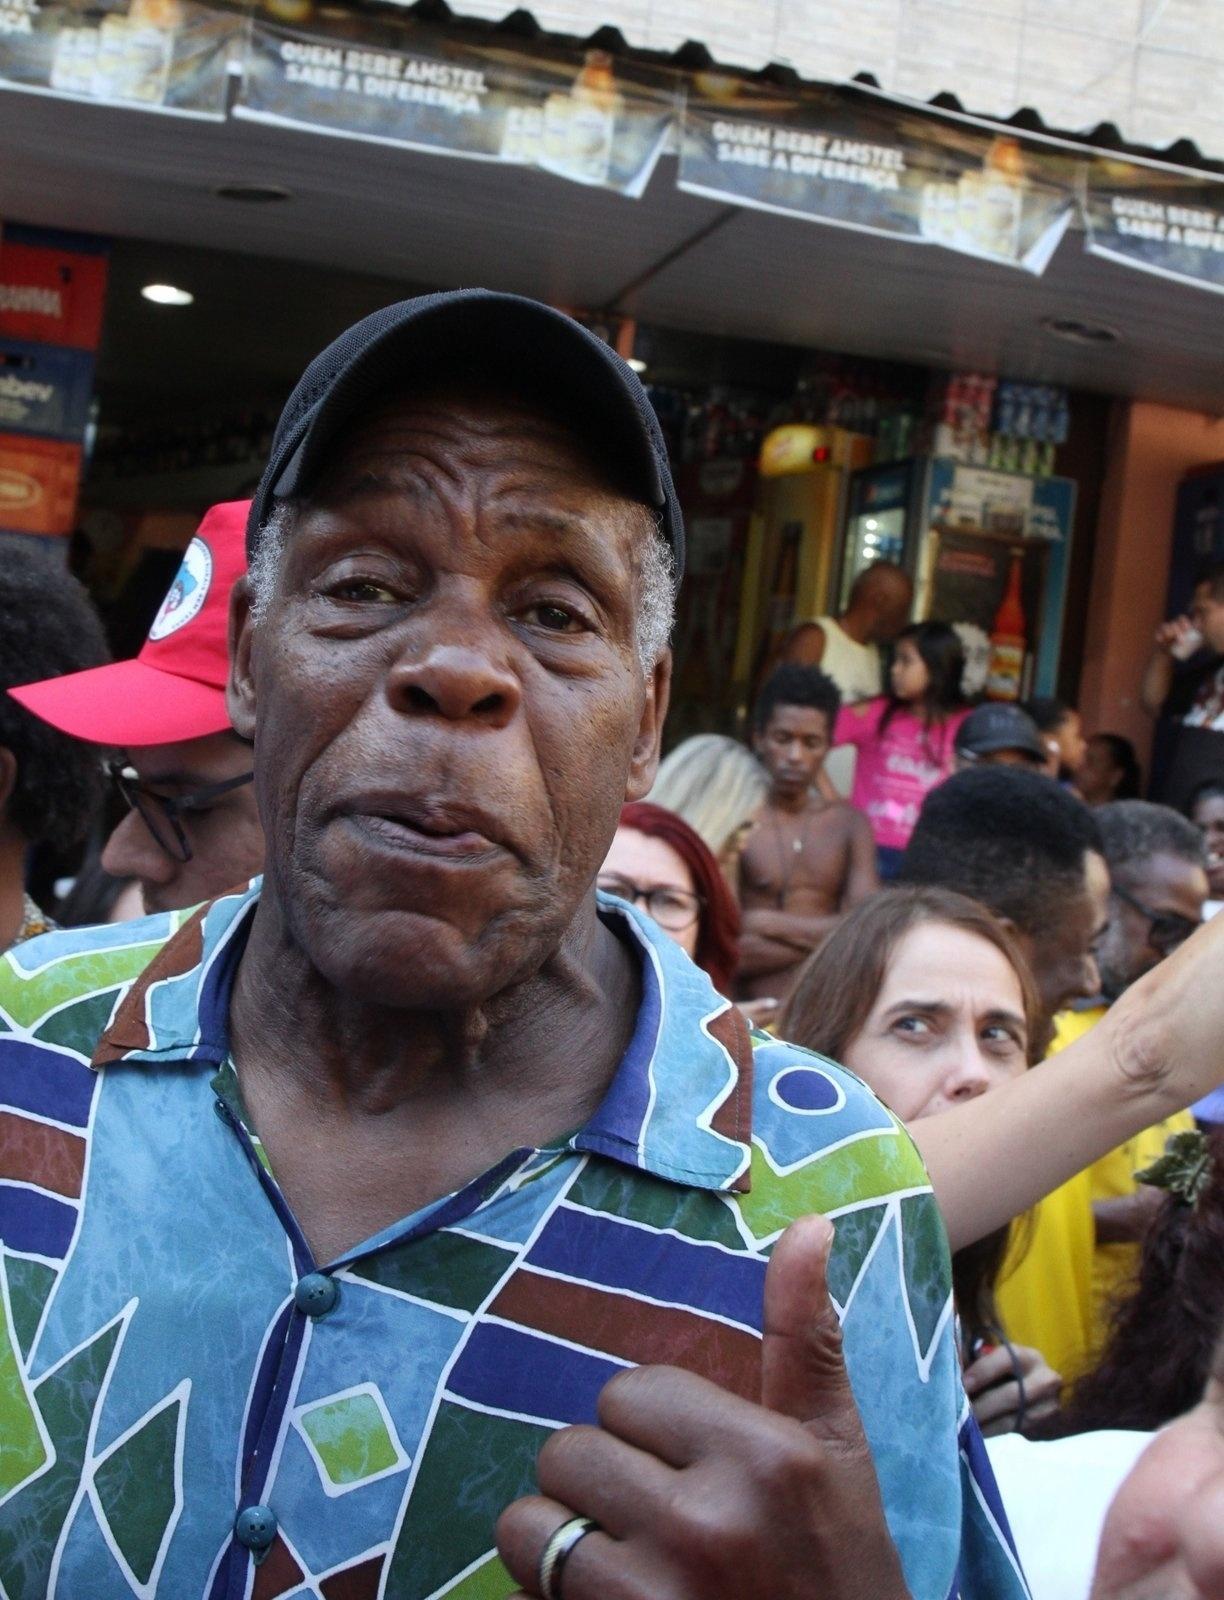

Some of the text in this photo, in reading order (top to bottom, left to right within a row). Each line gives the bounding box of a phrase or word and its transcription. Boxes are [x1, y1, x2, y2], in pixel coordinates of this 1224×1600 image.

[280, 41, 488, 95] QUEM BEBE AMSTEL
[286, 63, 342, 90] SABE
[344, 72, 360, 93] A
[712, 121, 907, 172] QUEM BEBE AMSTEL
[716, 142, 770, 169] SABE
[772, 152, 789, 171] A
[1112, 196, 1165, 220] QUEM
[1166, 204, 1216, 230] BEBE
[1117, 216, 1166, 242] SABE
[1168, 225, 1182, 243] A
